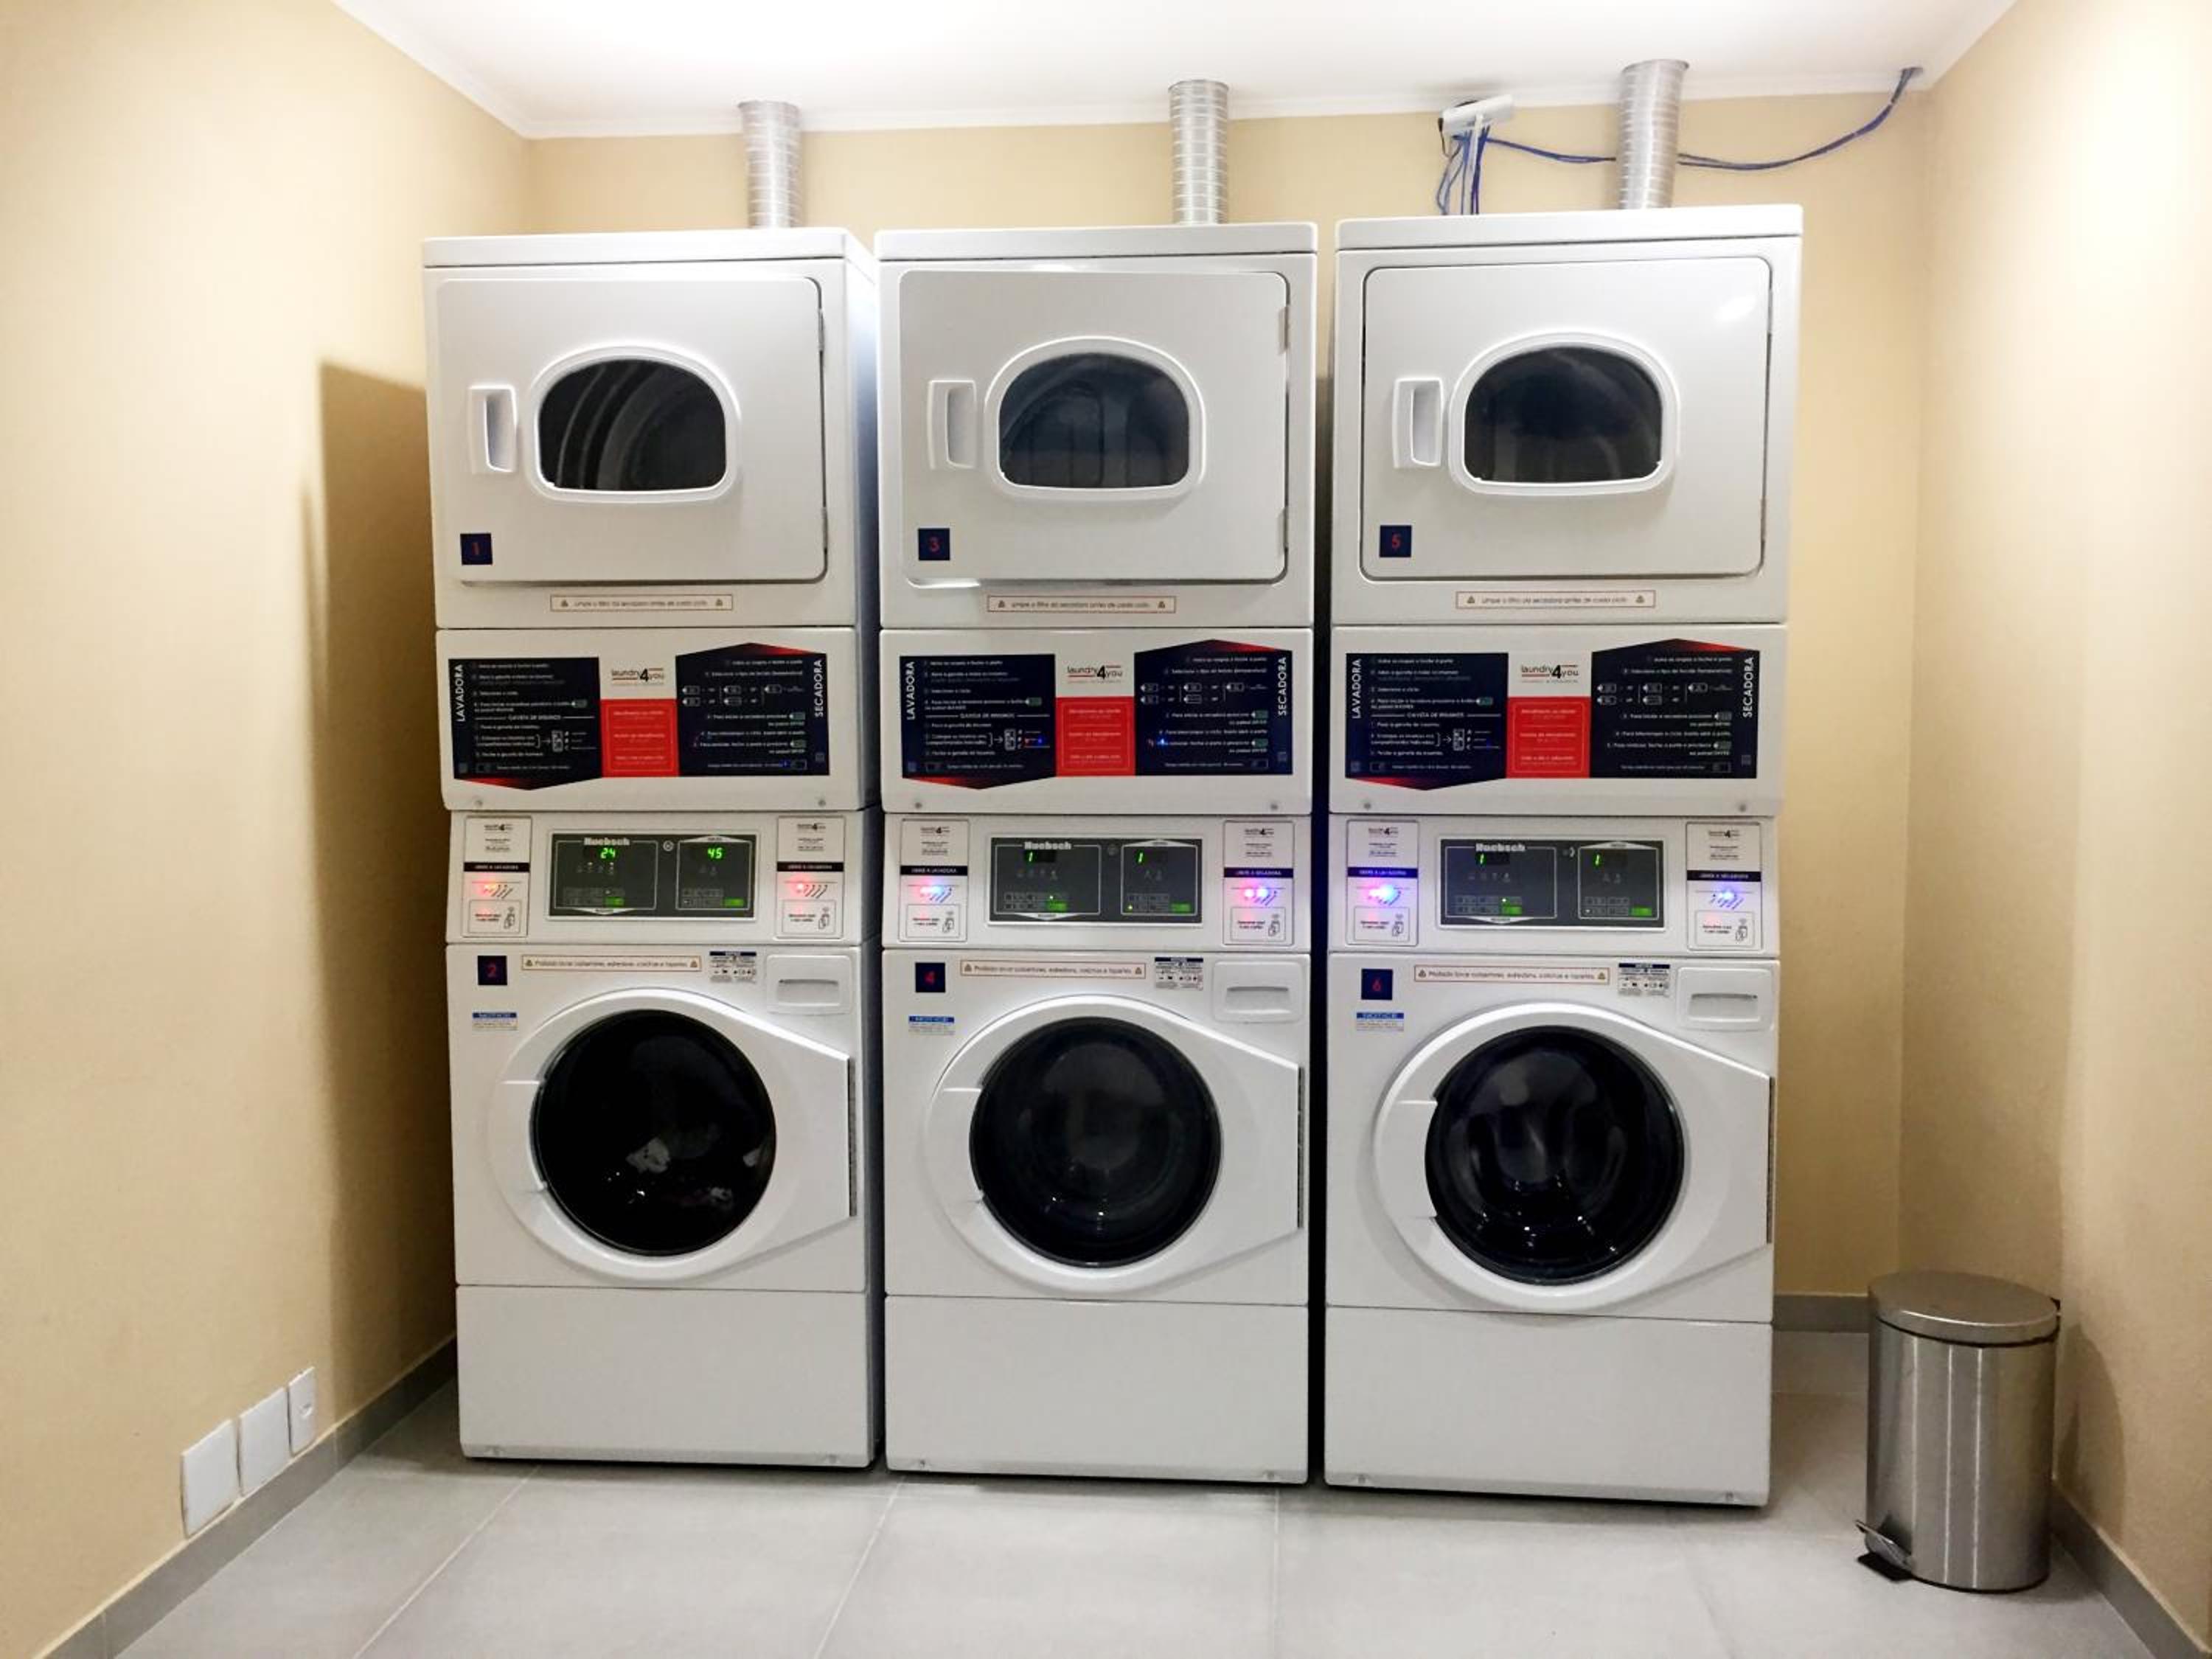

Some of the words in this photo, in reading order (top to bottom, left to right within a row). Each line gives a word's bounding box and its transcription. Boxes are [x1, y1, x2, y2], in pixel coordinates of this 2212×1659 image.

[928, 536, 940, 552] 3
[1067, 665, 1123, 679] laundry4you
[1520, 664, 1579, 679] laundry4you
[455, 664, 466, 722] LAVADORA
[815, 659, 824, 718] SECADORA
[906, 661, 916, 720] LAVADORA
[1277, 656, 1287, 716] SECADORA
[1352, 658, 1362, 719] LAVADORA
[1742, 656, 1754, 718] SECADORA
[599, 847, 616, 860] 24
[707, 847, 723, 860] 45
[487, 962, 497, 978] 2
[924, 970, 936, 985] 4
[1371, 977, 1382, 992] 6
